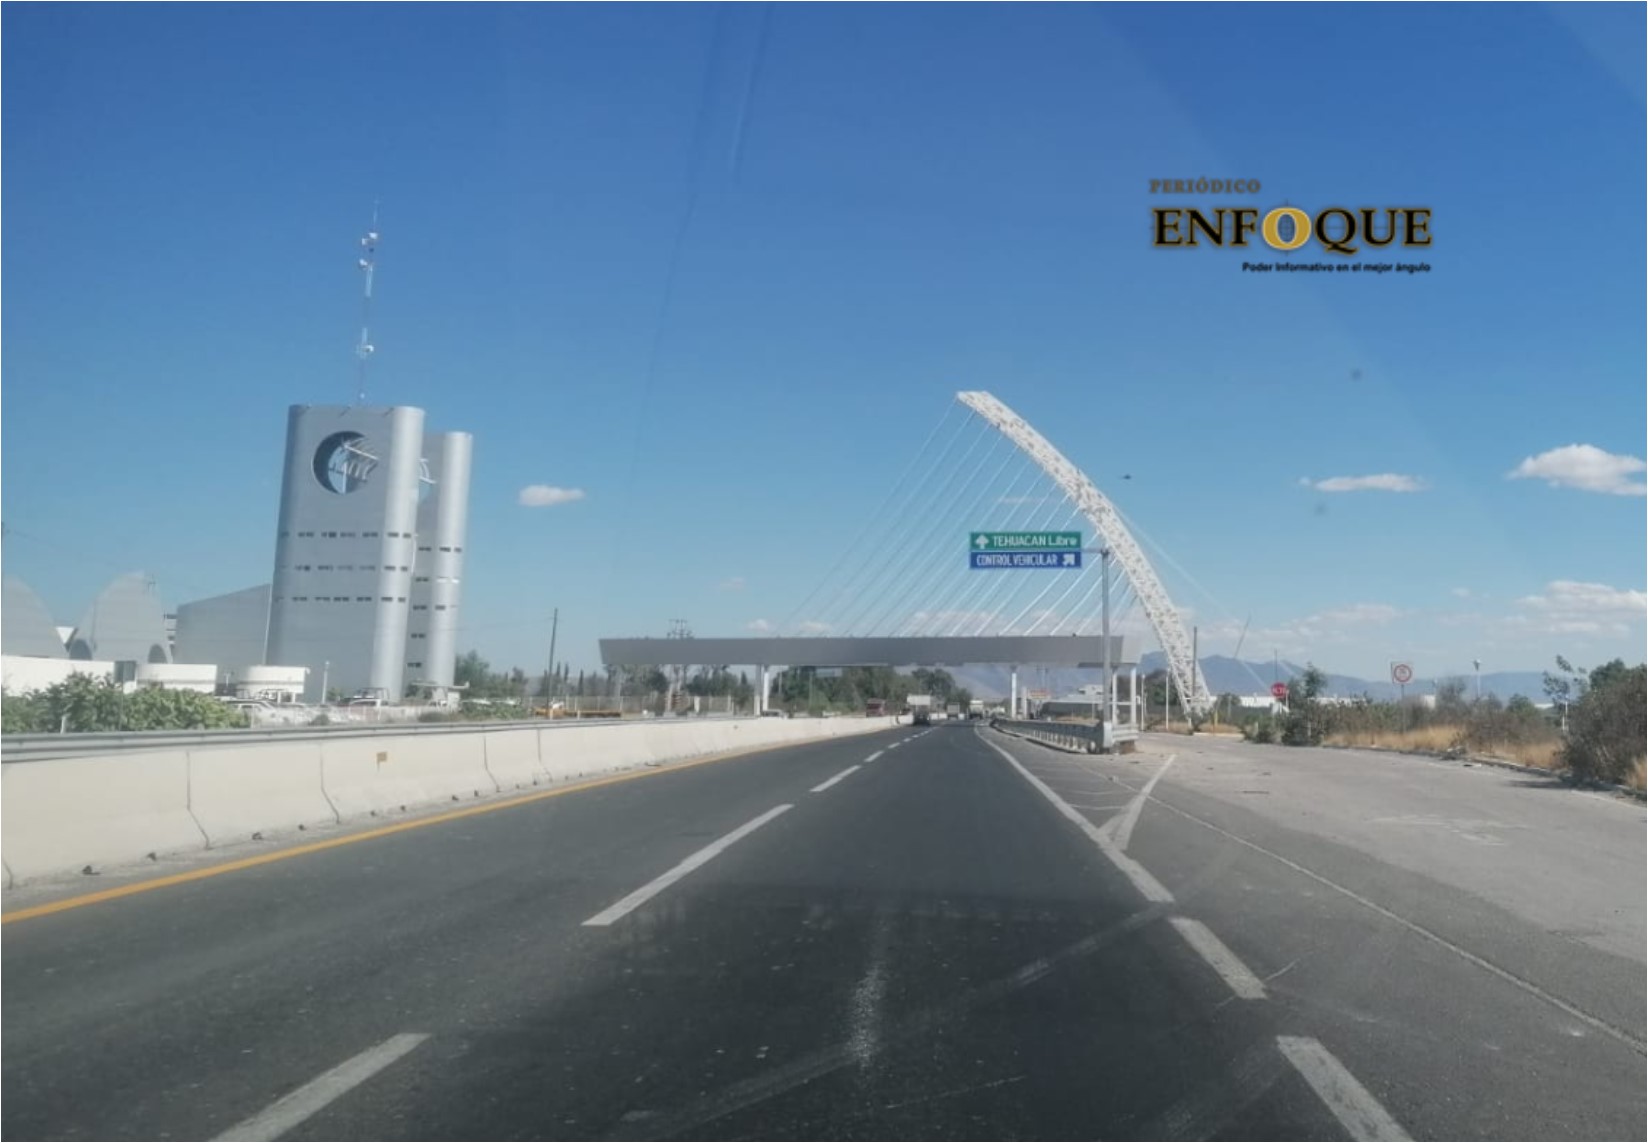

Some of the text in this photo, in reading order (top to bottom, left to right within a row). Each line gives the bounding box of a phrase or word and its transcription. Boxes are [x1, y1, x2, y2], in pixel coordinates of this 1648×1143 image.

[993, 535, 1077, 547] TEHUACAN Libre
[976, 553, 1058, 566] CONTROL VEHICULAR
